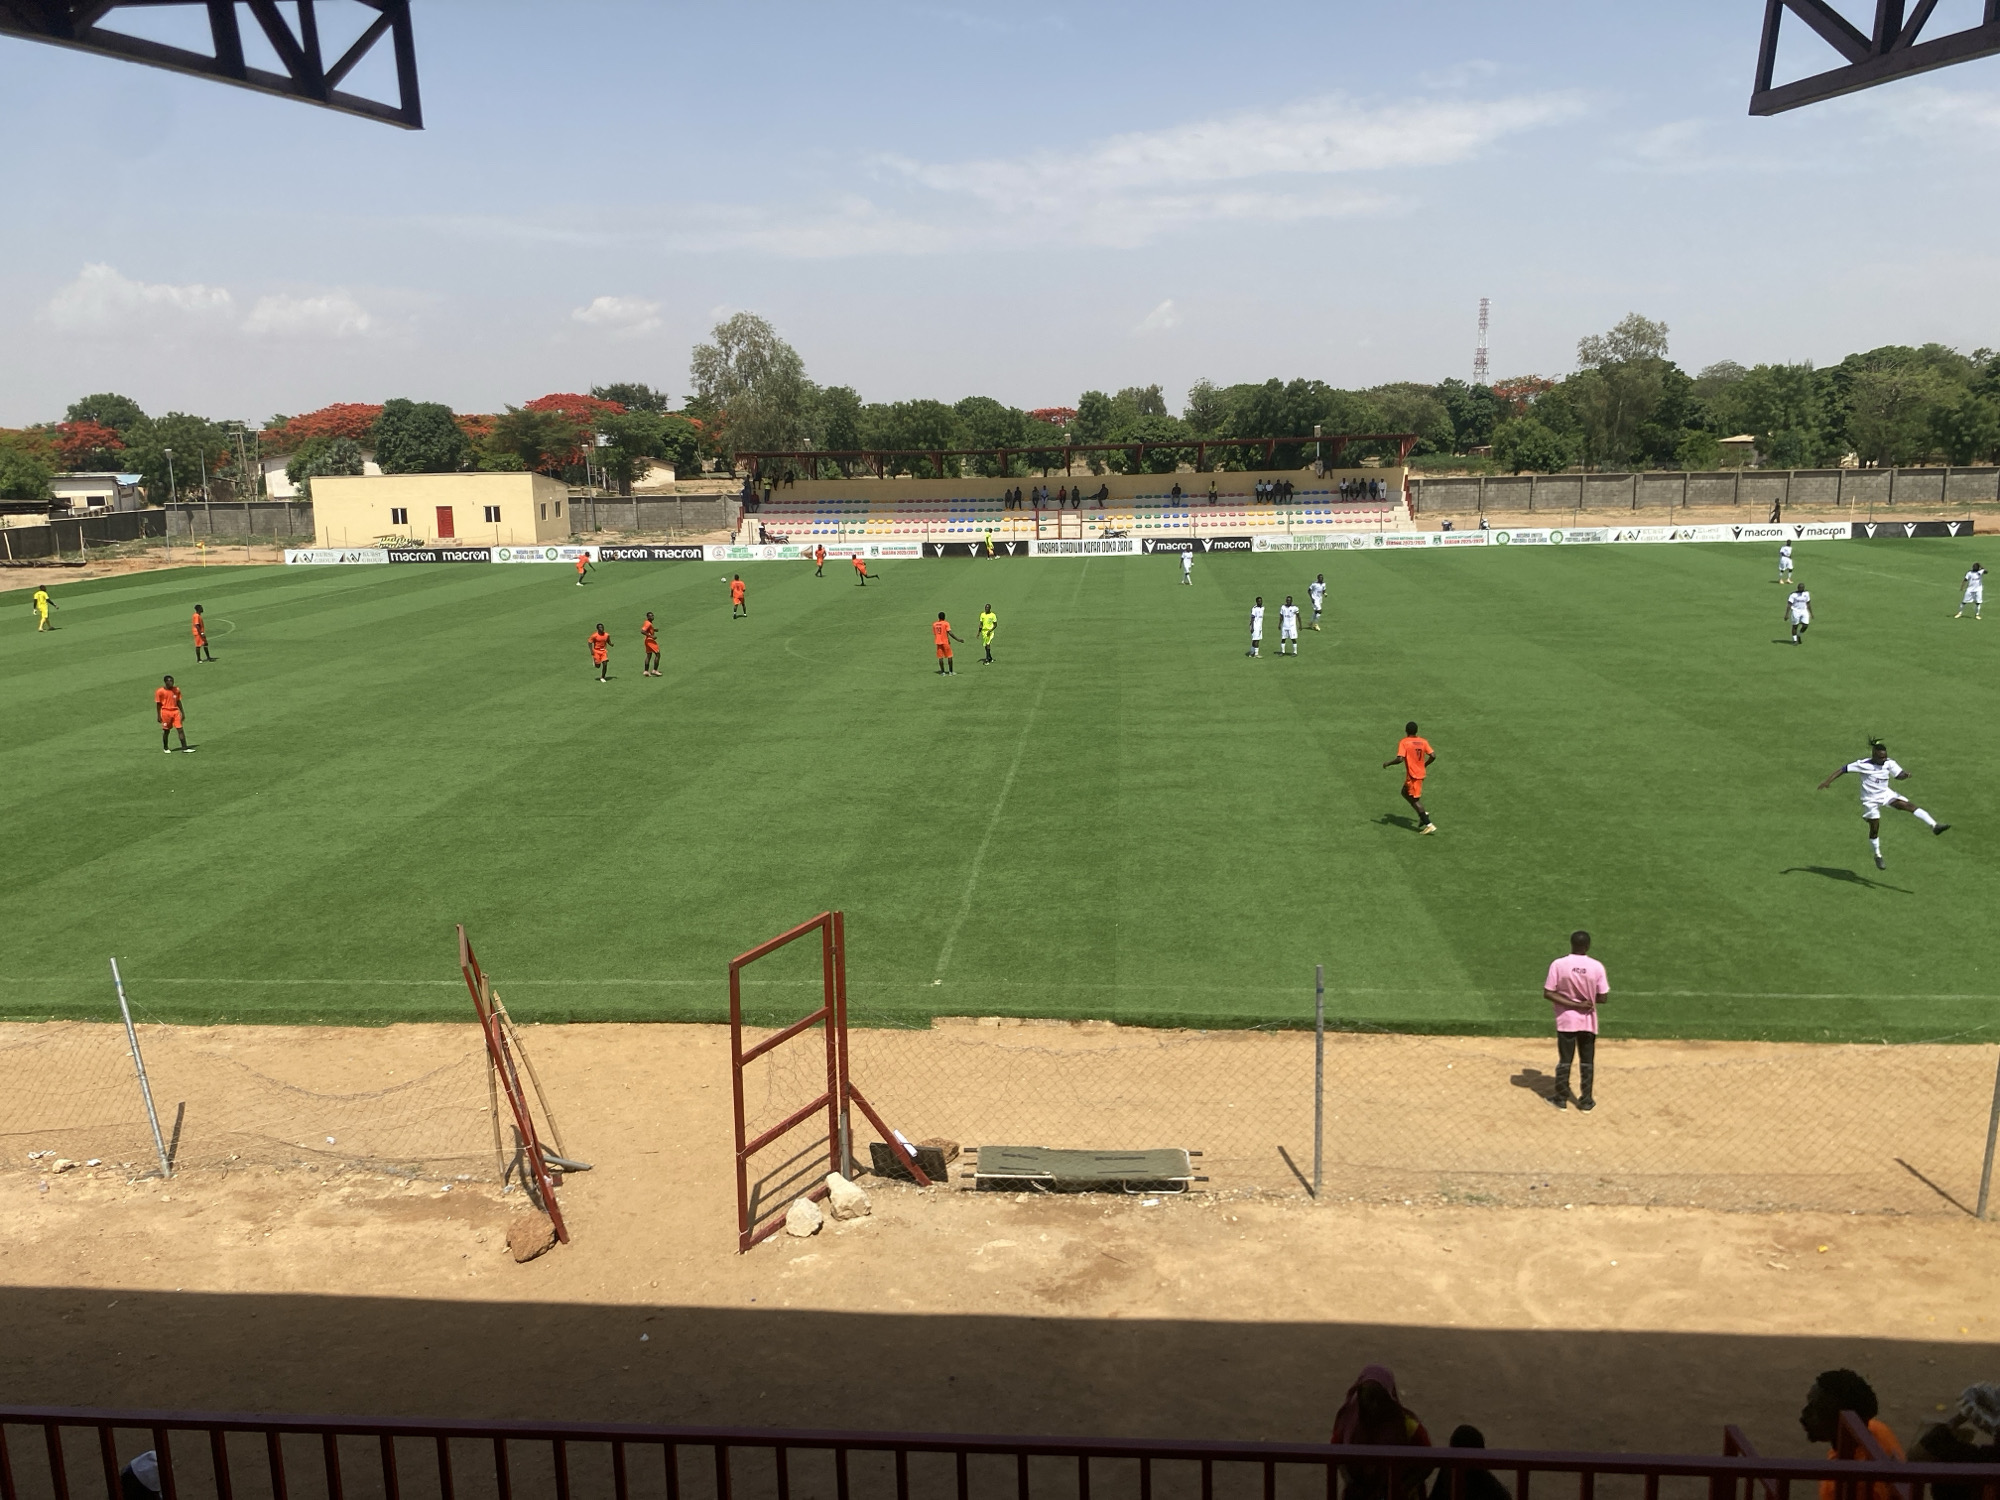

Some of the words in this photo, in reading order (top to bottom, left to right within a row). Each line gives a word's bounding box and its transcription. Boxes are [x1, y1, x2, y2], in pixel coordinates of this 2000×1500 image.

[1744, 527, 1783, 537] macron
[1806, 526, 1846, 536] macron
[1214, 540, 1250, 549] macron
[390, 552, 436, 561] macron
[442, 550, 489, 560] macron
[602, 549, 648, 559] macron
[655, 548, 702, 558] macron
